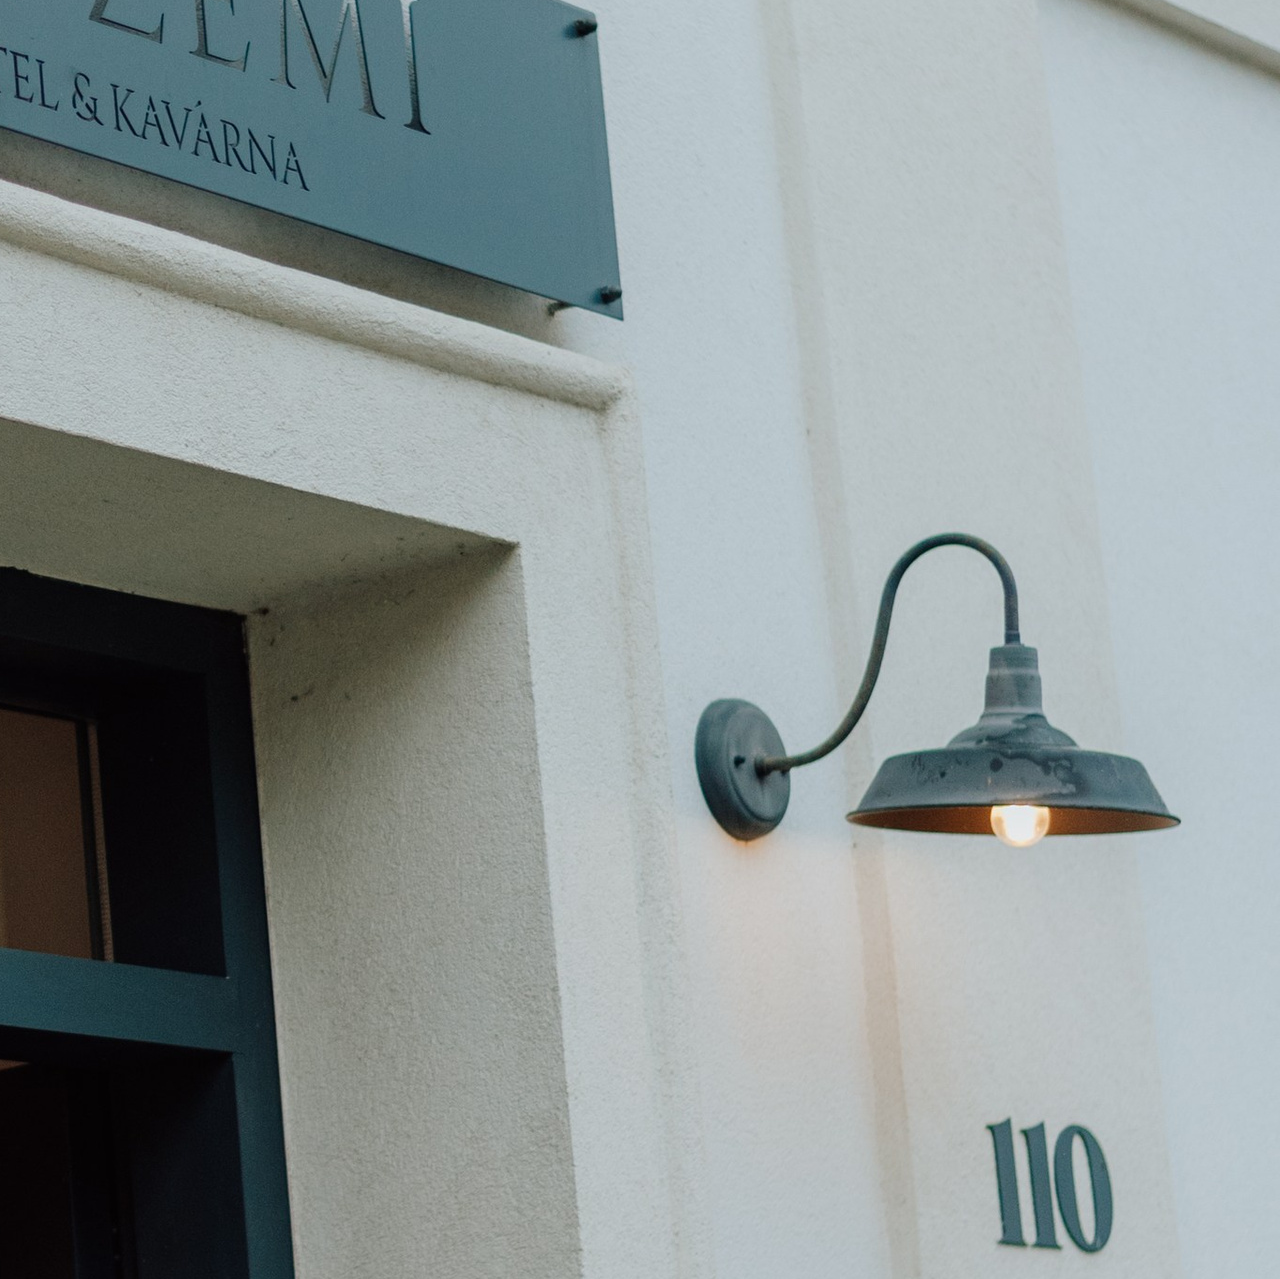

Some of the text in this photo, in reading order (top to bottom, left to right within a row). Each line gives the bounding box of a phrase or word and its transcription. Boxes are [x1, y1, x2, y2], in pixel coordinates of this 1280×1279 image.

[72, 72, 104, 126] &
[109, 83, 311, 193] KAVÁRNA
[985, 1116, 1113, 1253] 110
